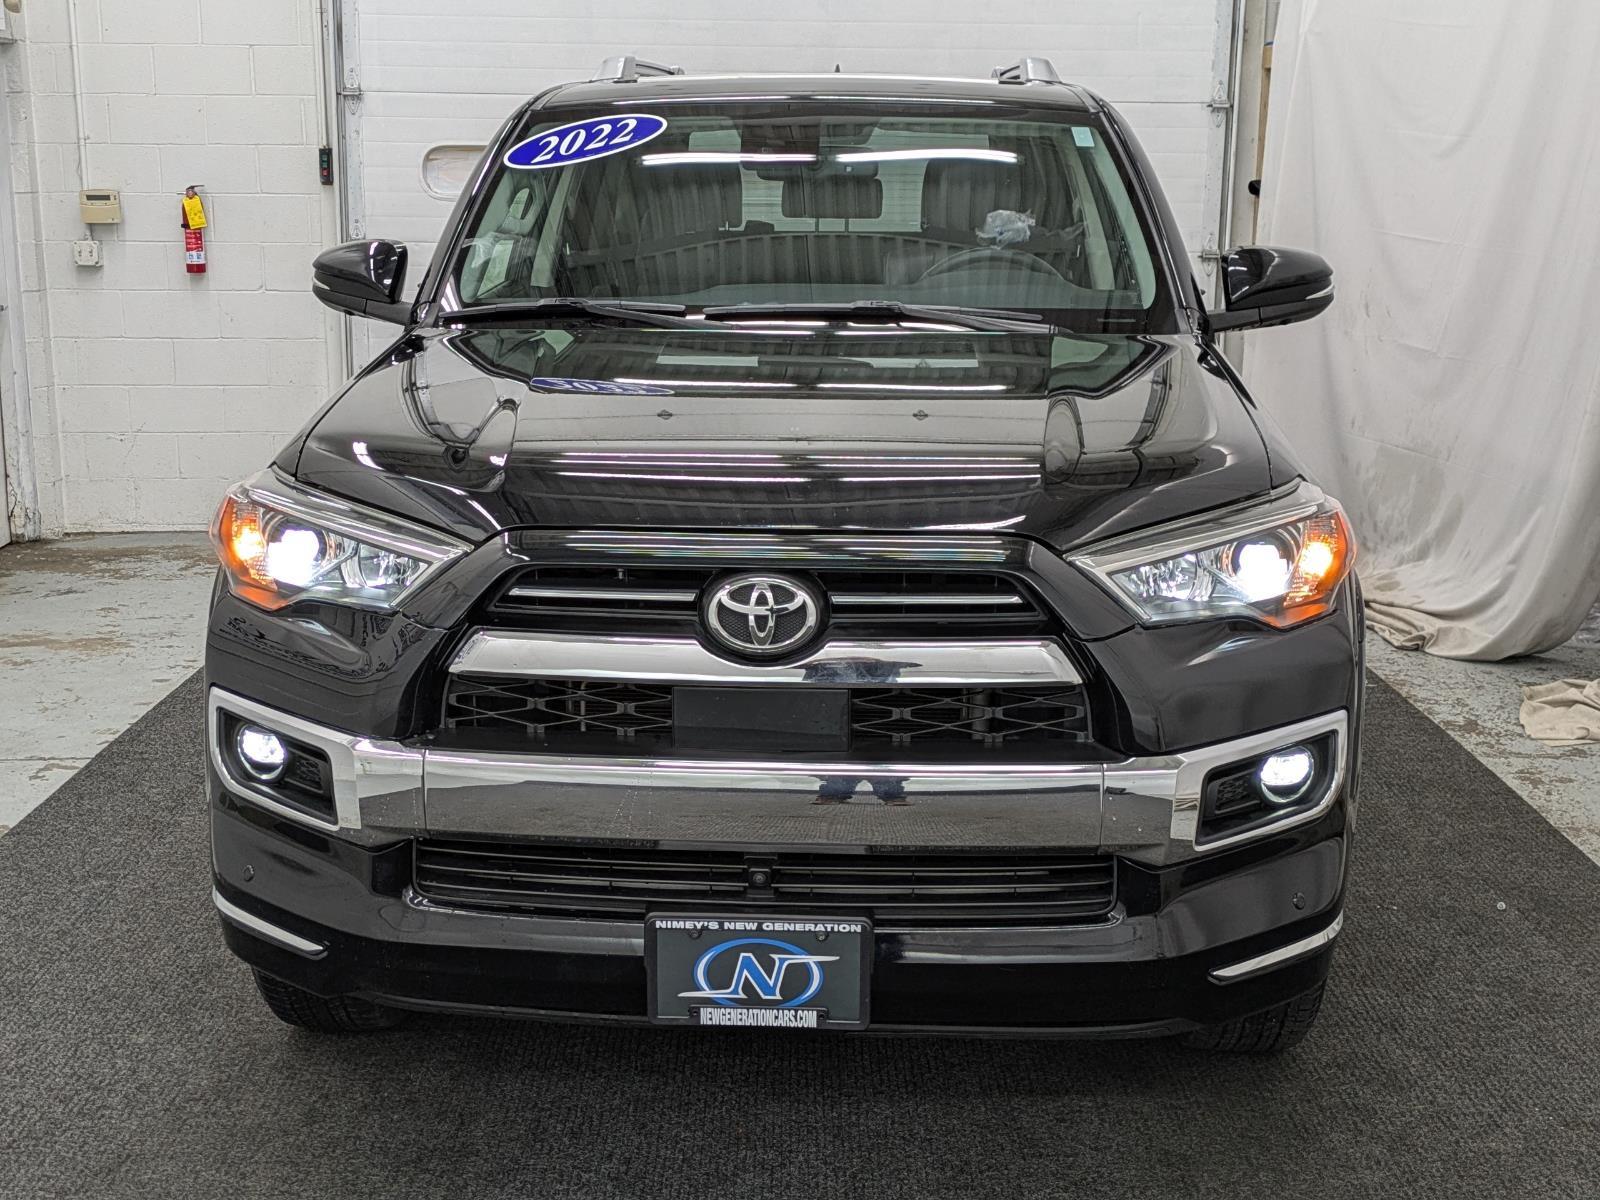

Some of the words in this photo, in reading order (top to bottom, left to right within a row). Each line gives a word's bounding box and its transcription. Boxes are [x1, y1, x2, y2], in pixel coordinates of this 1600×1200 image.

[530, 118, 638, 164] 2022
[655, 920, 720, 930] NIMEY'S
[723, 921, 758, 930] NEW
[762, 922, 862, 933] GENERATION
[700, 1007, 818, 1028] NEWGENERATIONCARS.COM
